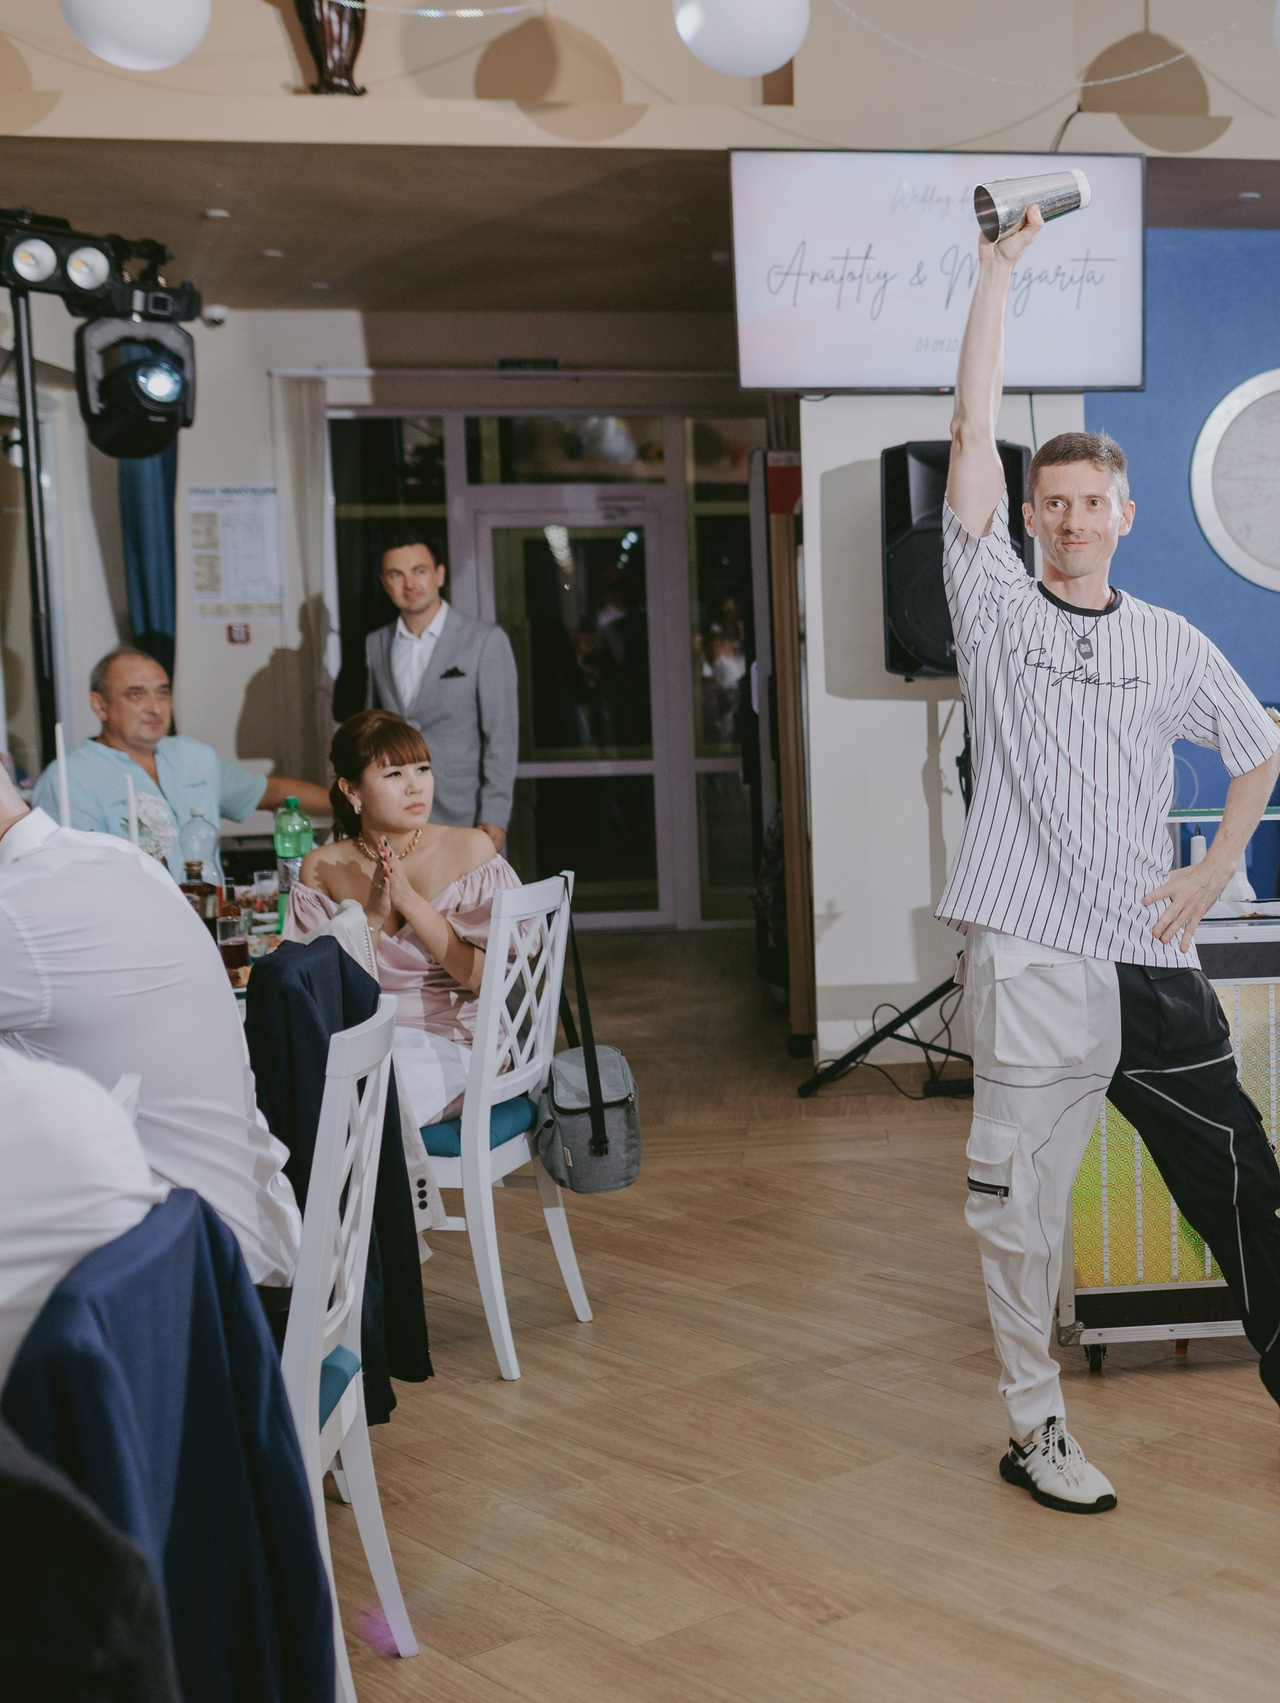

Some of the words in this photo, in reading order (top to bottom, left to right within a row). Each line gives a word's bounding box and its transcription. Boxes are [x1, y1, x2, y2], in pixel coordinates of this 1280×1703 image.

[908, 260, 928, 288] &
[939, 244, 1116, 319] Mrgarita
[1024, 647, 1152, 690] Confident
